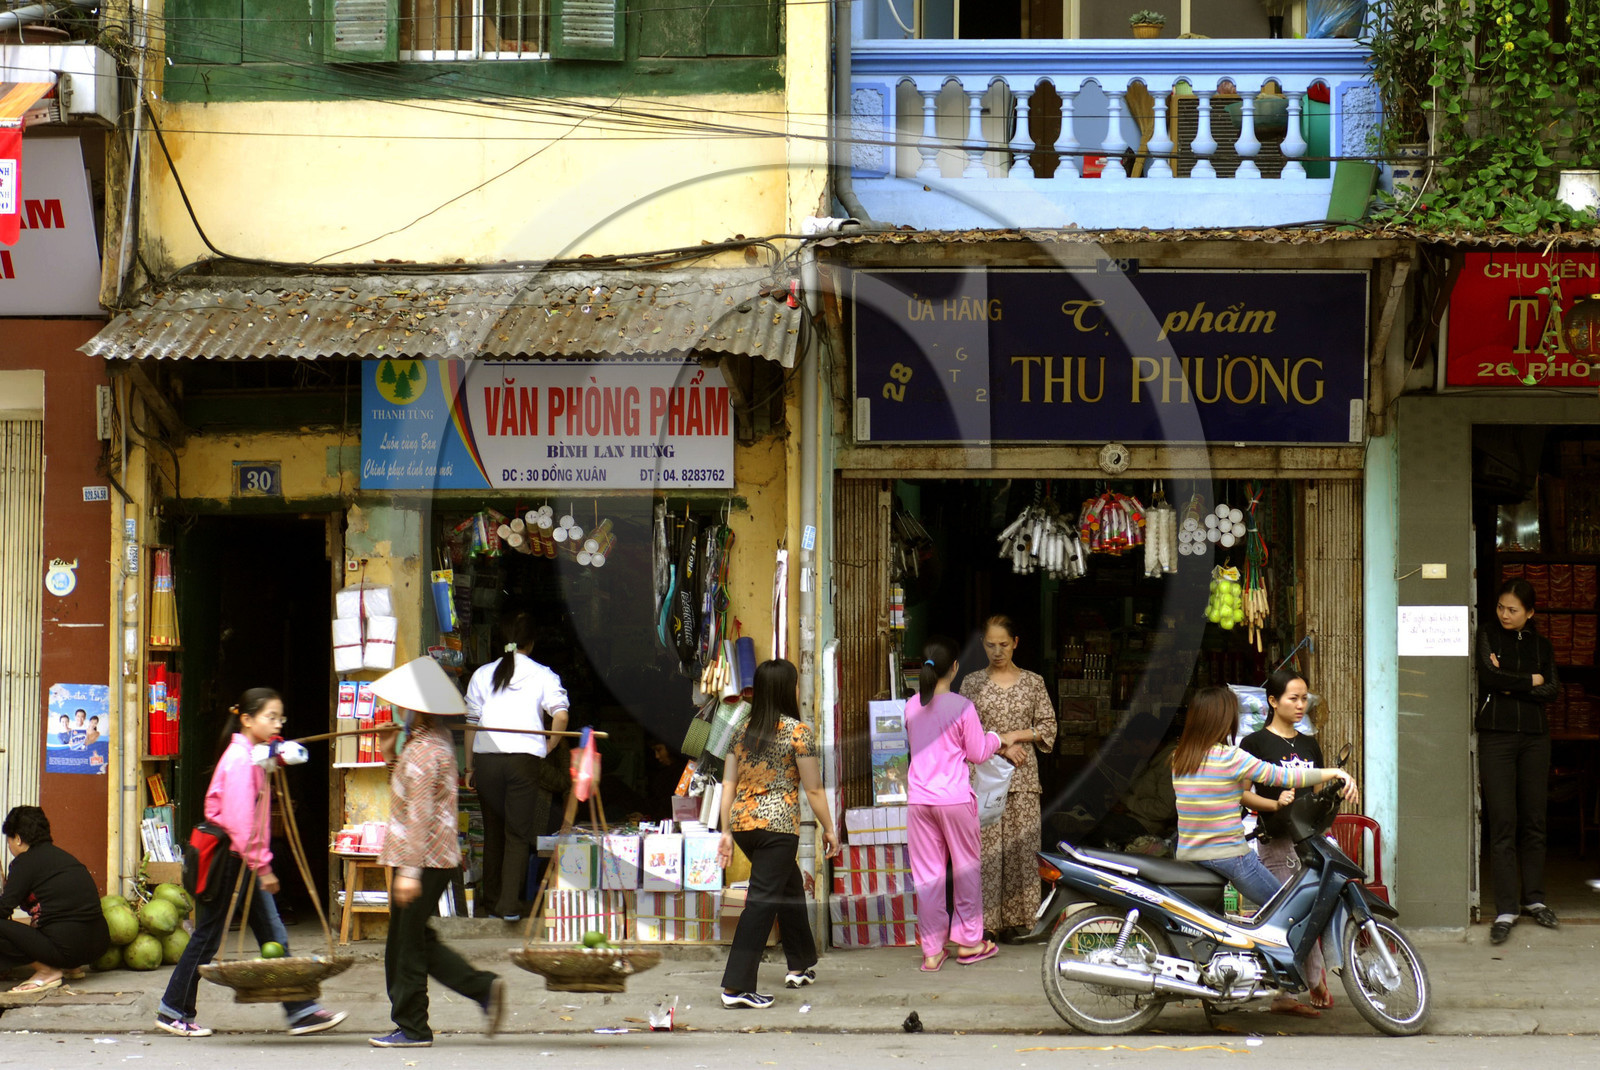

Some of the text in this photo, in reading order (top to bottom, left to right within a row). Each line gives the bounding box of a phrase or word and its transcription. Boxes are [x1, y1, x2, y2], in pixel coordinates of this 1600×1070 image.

[1156, 300, 1278, 342] phẩm
[1011, 354, 1325, 405] THU PHƯƠNG
[483, 369, 729, 437] VĂN PHÒNG PHẨM
[371, 407, 434, 420] THANH TÙNG
[546, 441, 676, 459] BÌNH LAN HƯNG
[246, 470, 272, 491] 30
[526, 469, 539, 482] 30
[542, 463, 573, 482] ĐỒNG
[576, 465, 607, 482] XUÂN
[640, 469, 655, 482] ĐT
[682, 469, 725, 482] 8283762
